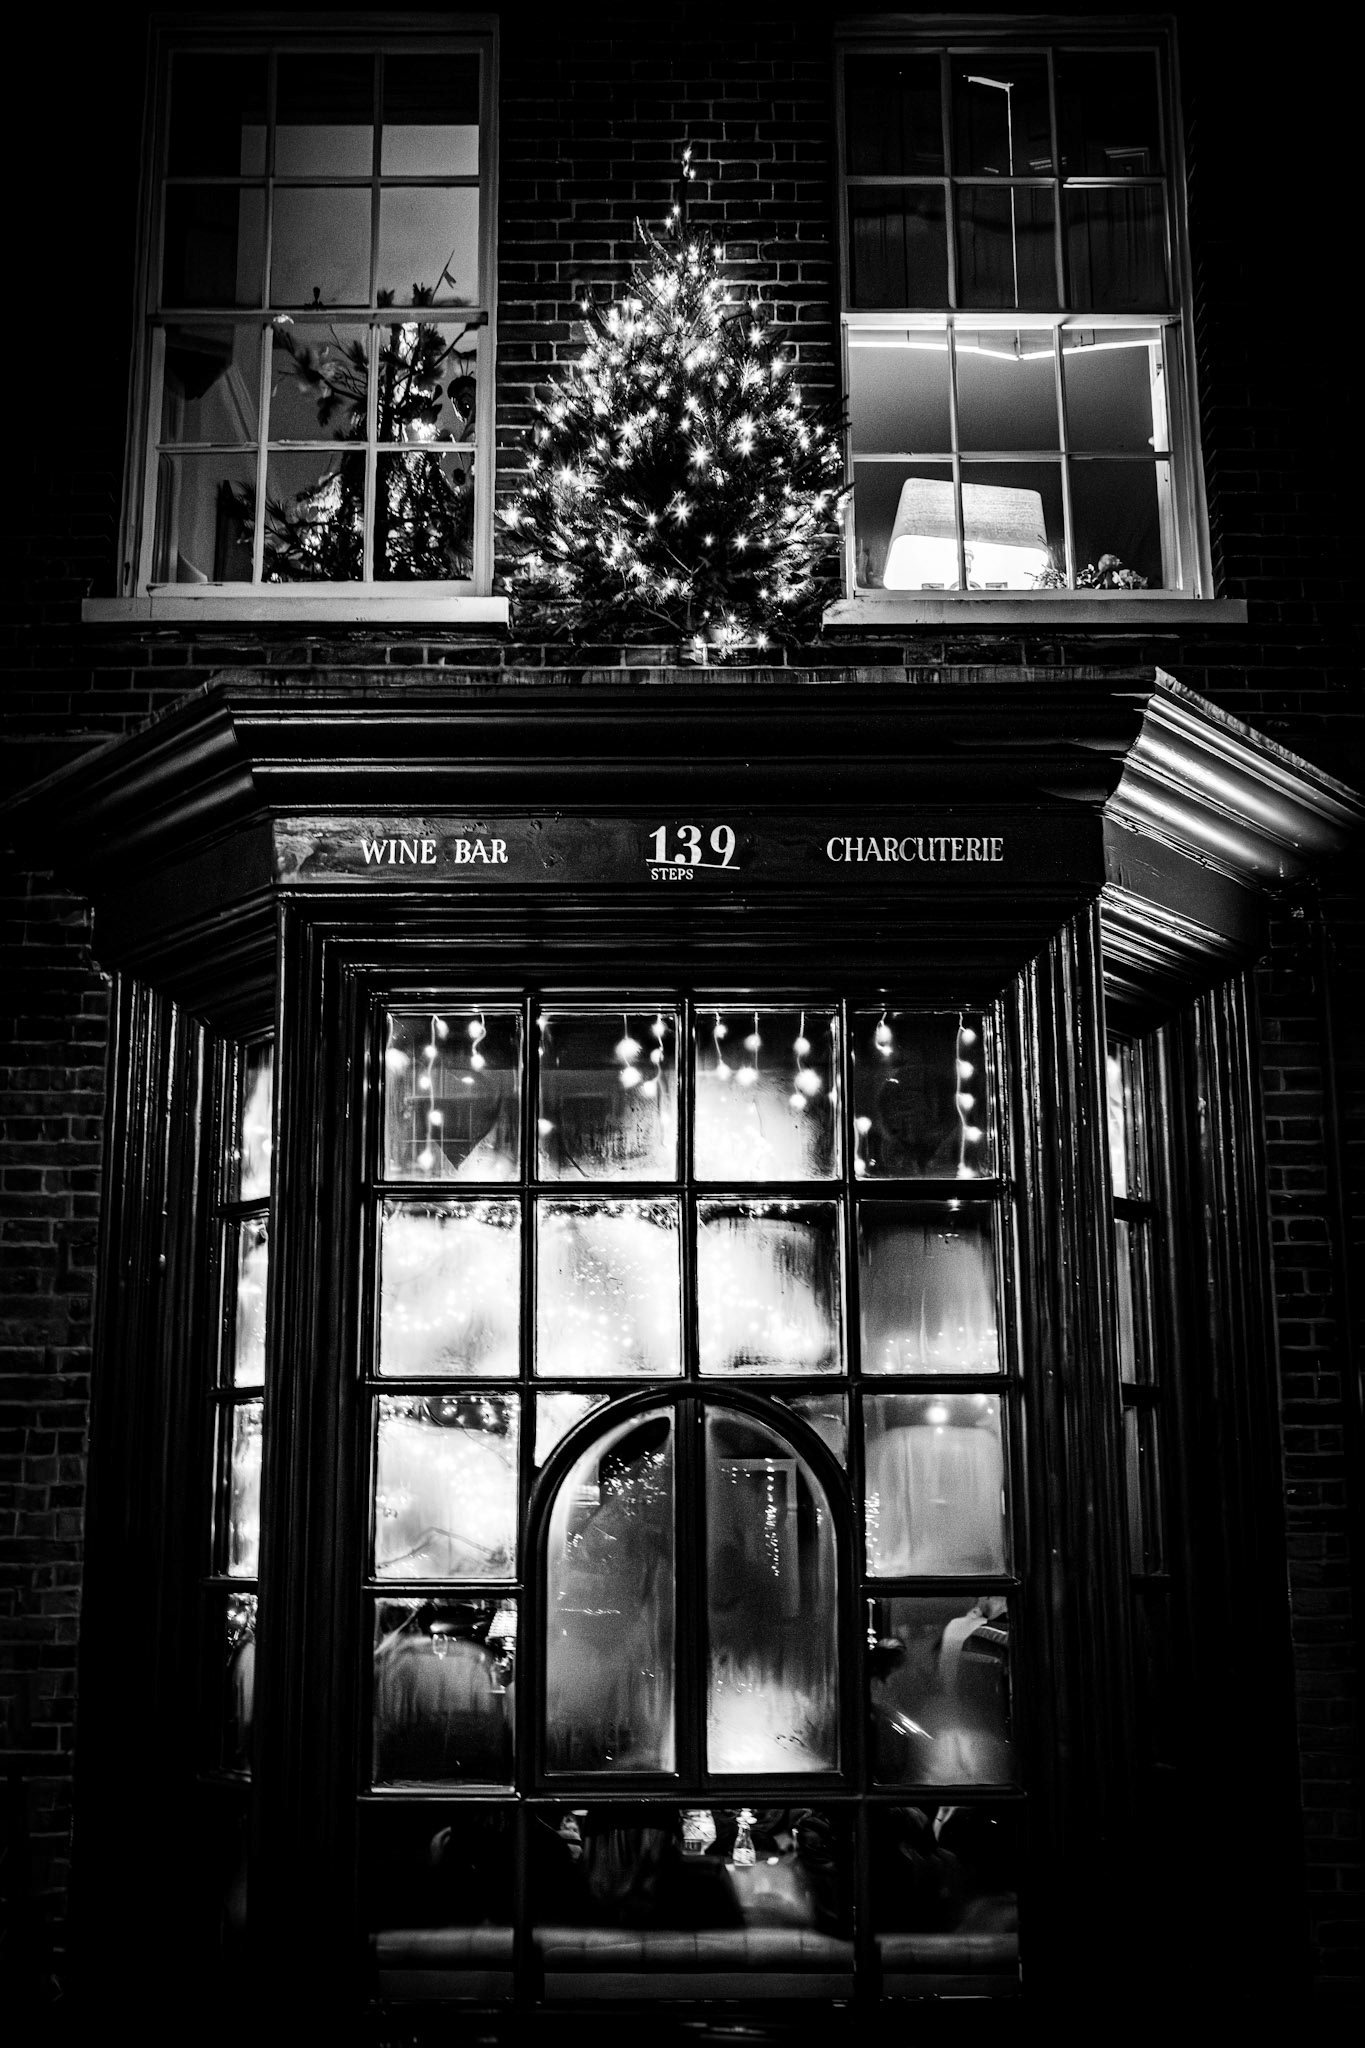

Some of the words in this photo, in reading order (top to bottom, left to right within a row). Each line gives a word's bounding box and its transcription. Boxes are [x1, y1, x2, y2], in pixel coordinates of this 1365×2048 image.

[361, 838, 437, 865] WINE
[454, 838, 509, 864] BAR
[649, 825, 737, 868] 139
[826, 837, 1004, 862] CHARCUTERIE
[650, 867, 694, 881] STEPS
